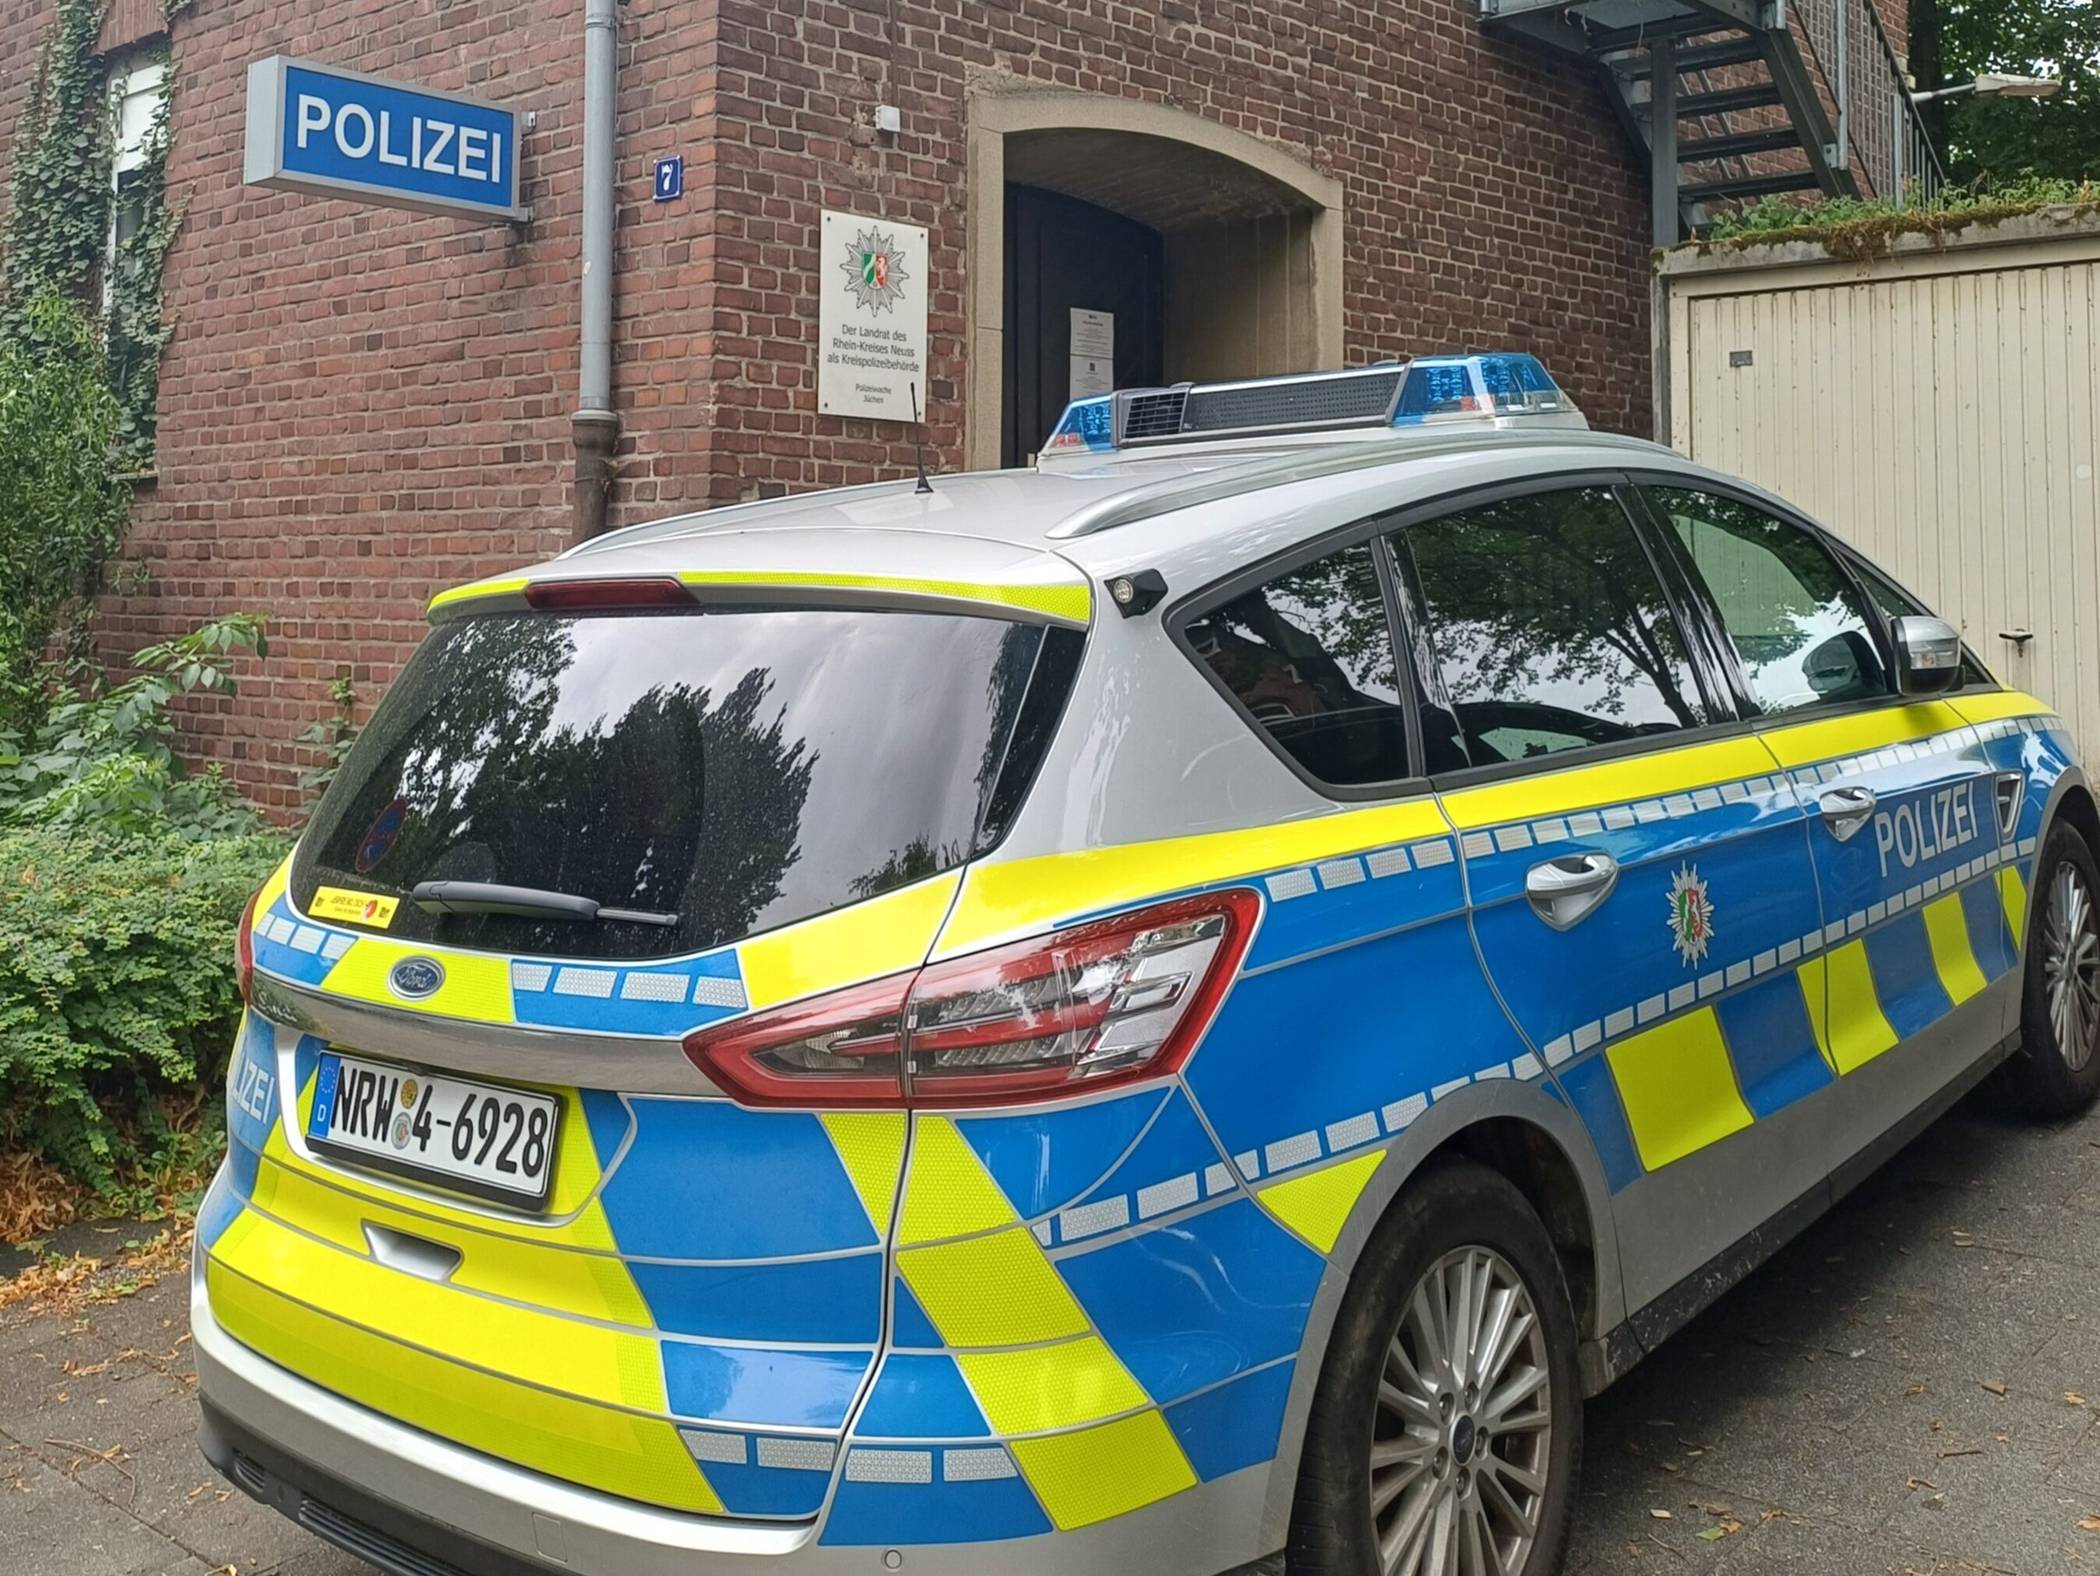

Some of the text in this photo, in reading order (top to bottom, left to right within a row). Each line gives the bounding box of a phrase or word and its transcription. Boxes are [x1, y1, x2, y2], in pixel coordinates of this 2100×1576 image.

[297, 93, 501, 184] POLIZEI
[661, 163, 674, 191] 7
[841, 323, 907, 342] Der Landrat des
[827, 352, 840, 364] als
[832, 337, 915, 357] Rhein-Kreises Neuss
[1874, 780, 1978, 878] POLIZEI
[317, 1103, 327, 1122] D
[330, 1065, 549, 1178] NRW 4-6928
